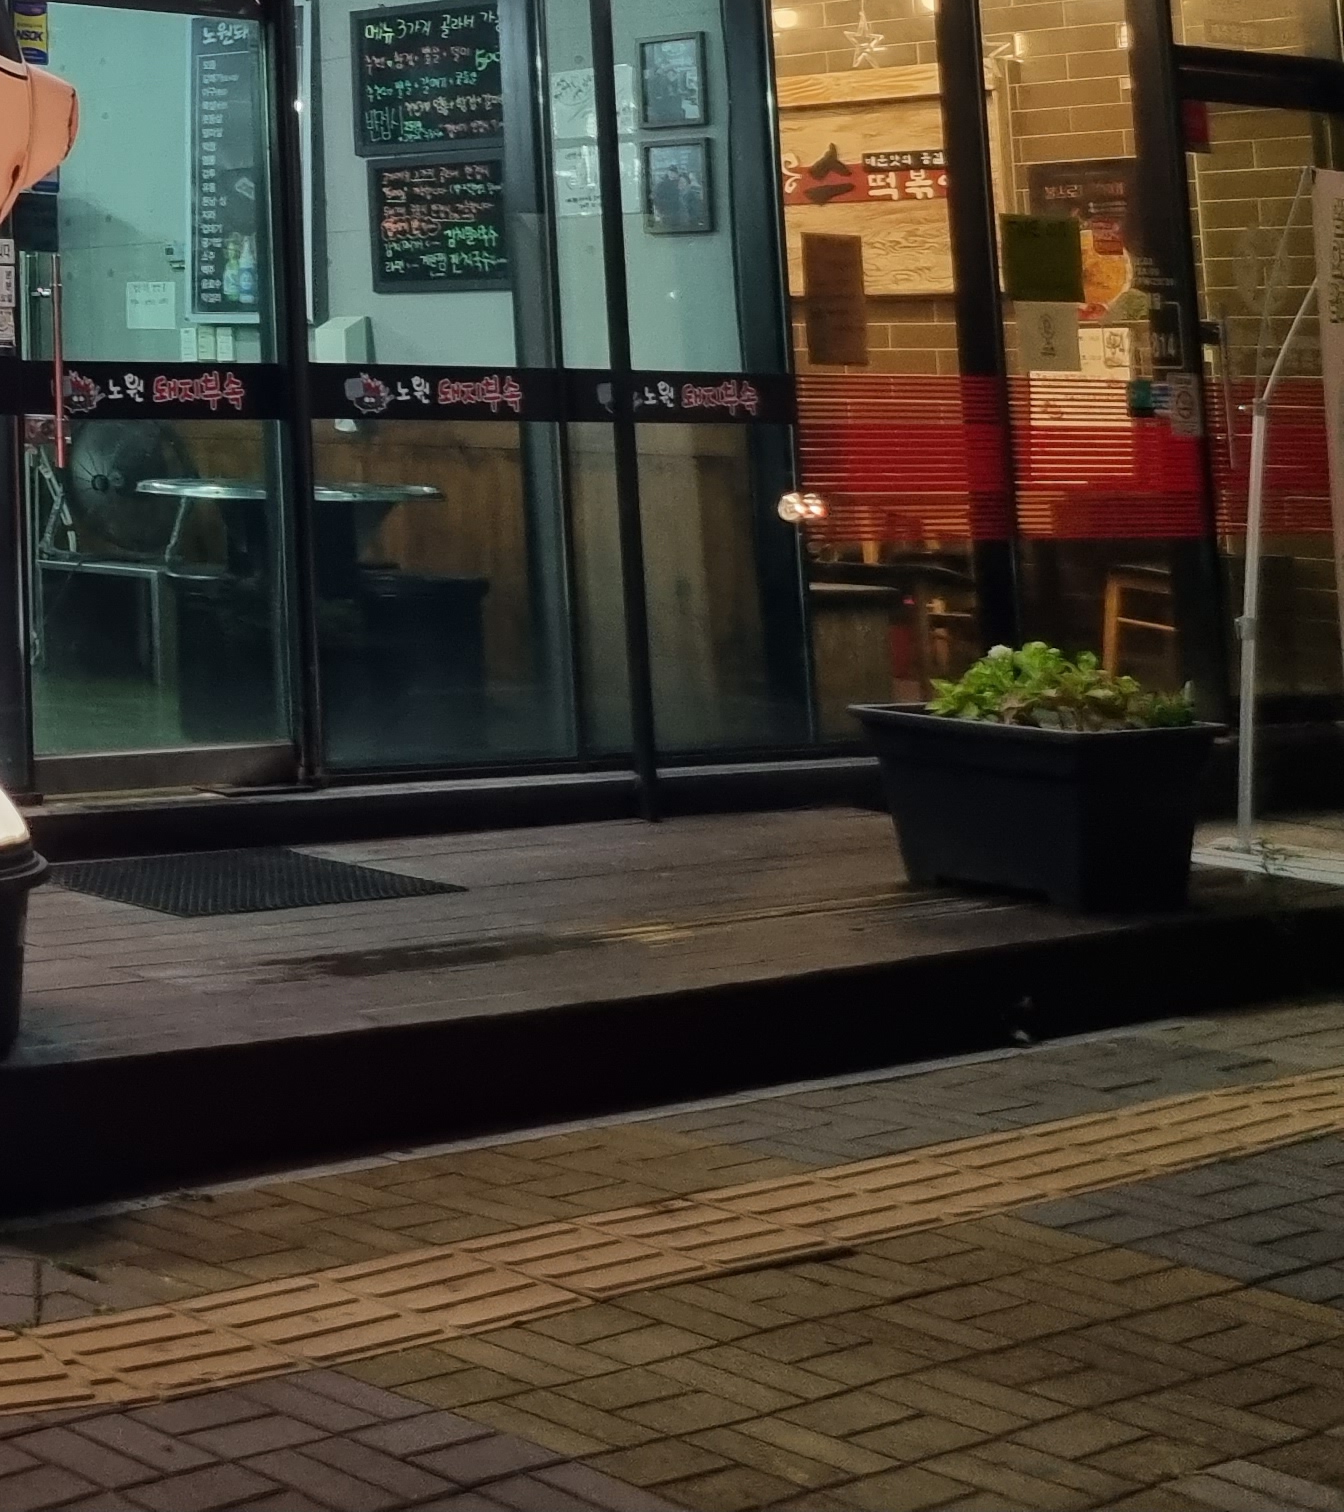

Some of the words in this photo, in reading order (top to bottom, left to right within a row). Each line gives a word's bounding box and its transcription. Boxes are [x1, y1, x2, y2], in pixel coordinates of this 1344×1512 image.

[203, 21, 250, 46] 노원돼
[150, 369, 247, 411] 돼지부속
[436, 372, 524, 413] 돼지부속
[680, 377, 759, 418] 돼지부속
